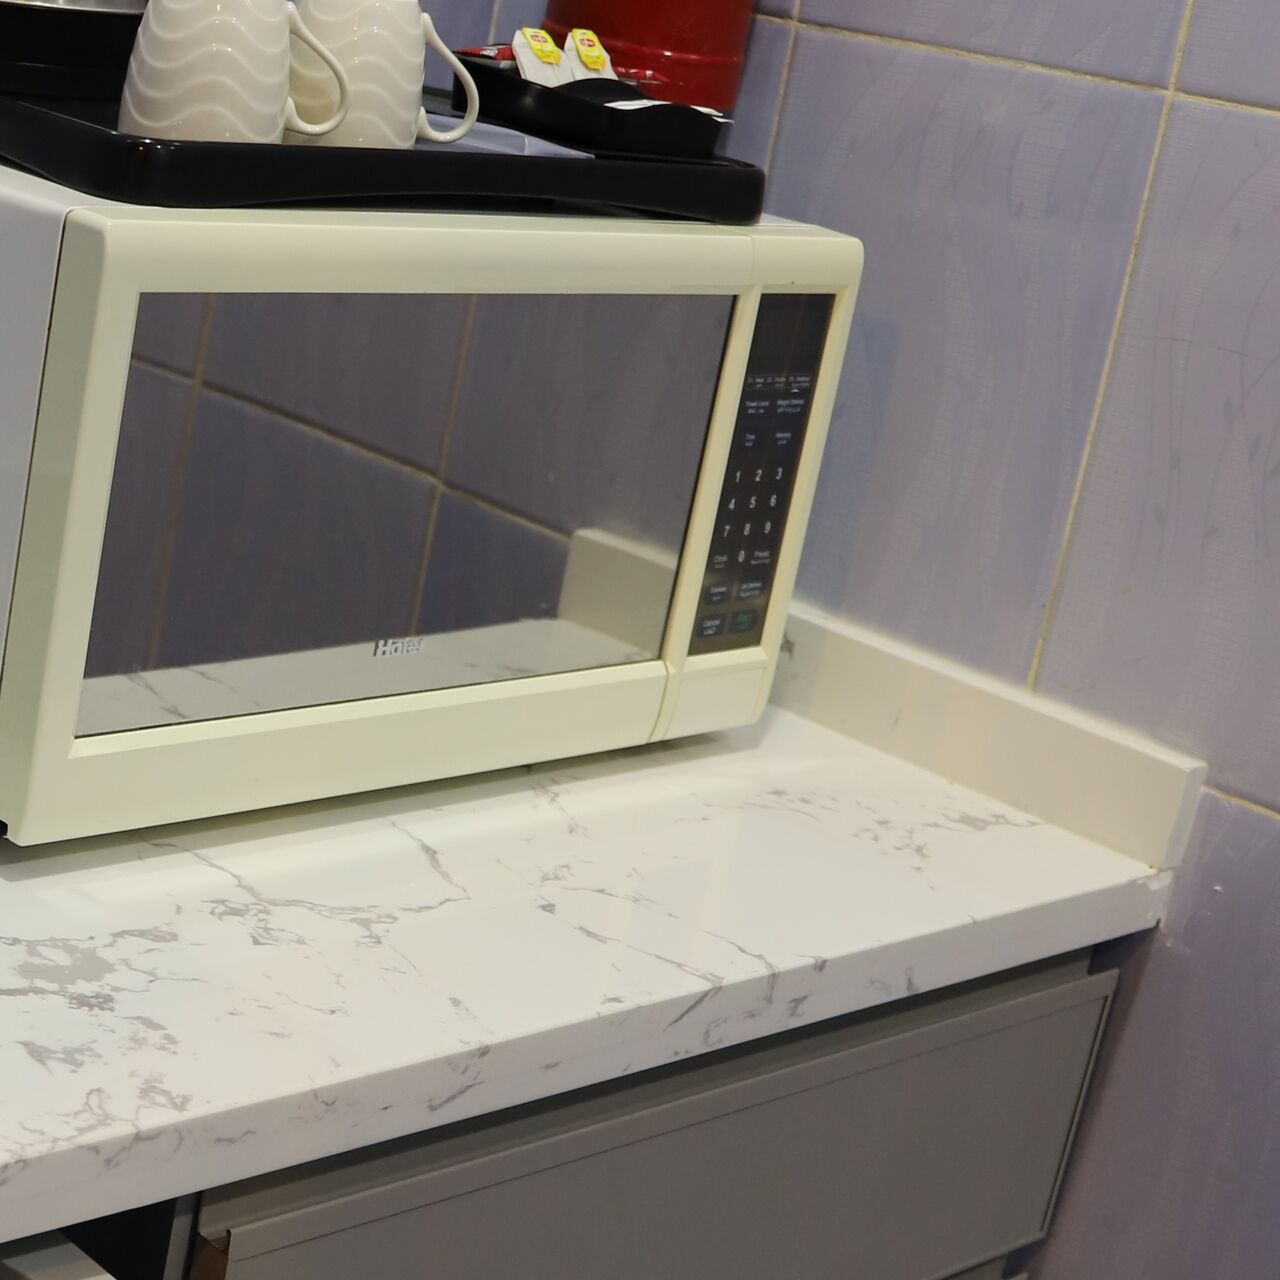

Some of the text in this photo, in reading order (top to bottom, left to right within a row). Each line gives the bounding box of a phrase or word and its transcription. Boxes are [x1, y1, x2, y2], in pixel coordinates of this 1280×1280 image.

[736, 470, 741, 483] 1
[755, 469, 762, 482] 2
[776, 467, 783, 480] 3
[728, 498, 736, 511] 4
[749, 496, 757, 509] 5
[770, 494, 777, 507] 6
[723, 525, 730, 538] 7
[744, 523, 751, 536] 8
[764, 521, 771, 534] 9
[738, 550, 745, 562] 0
